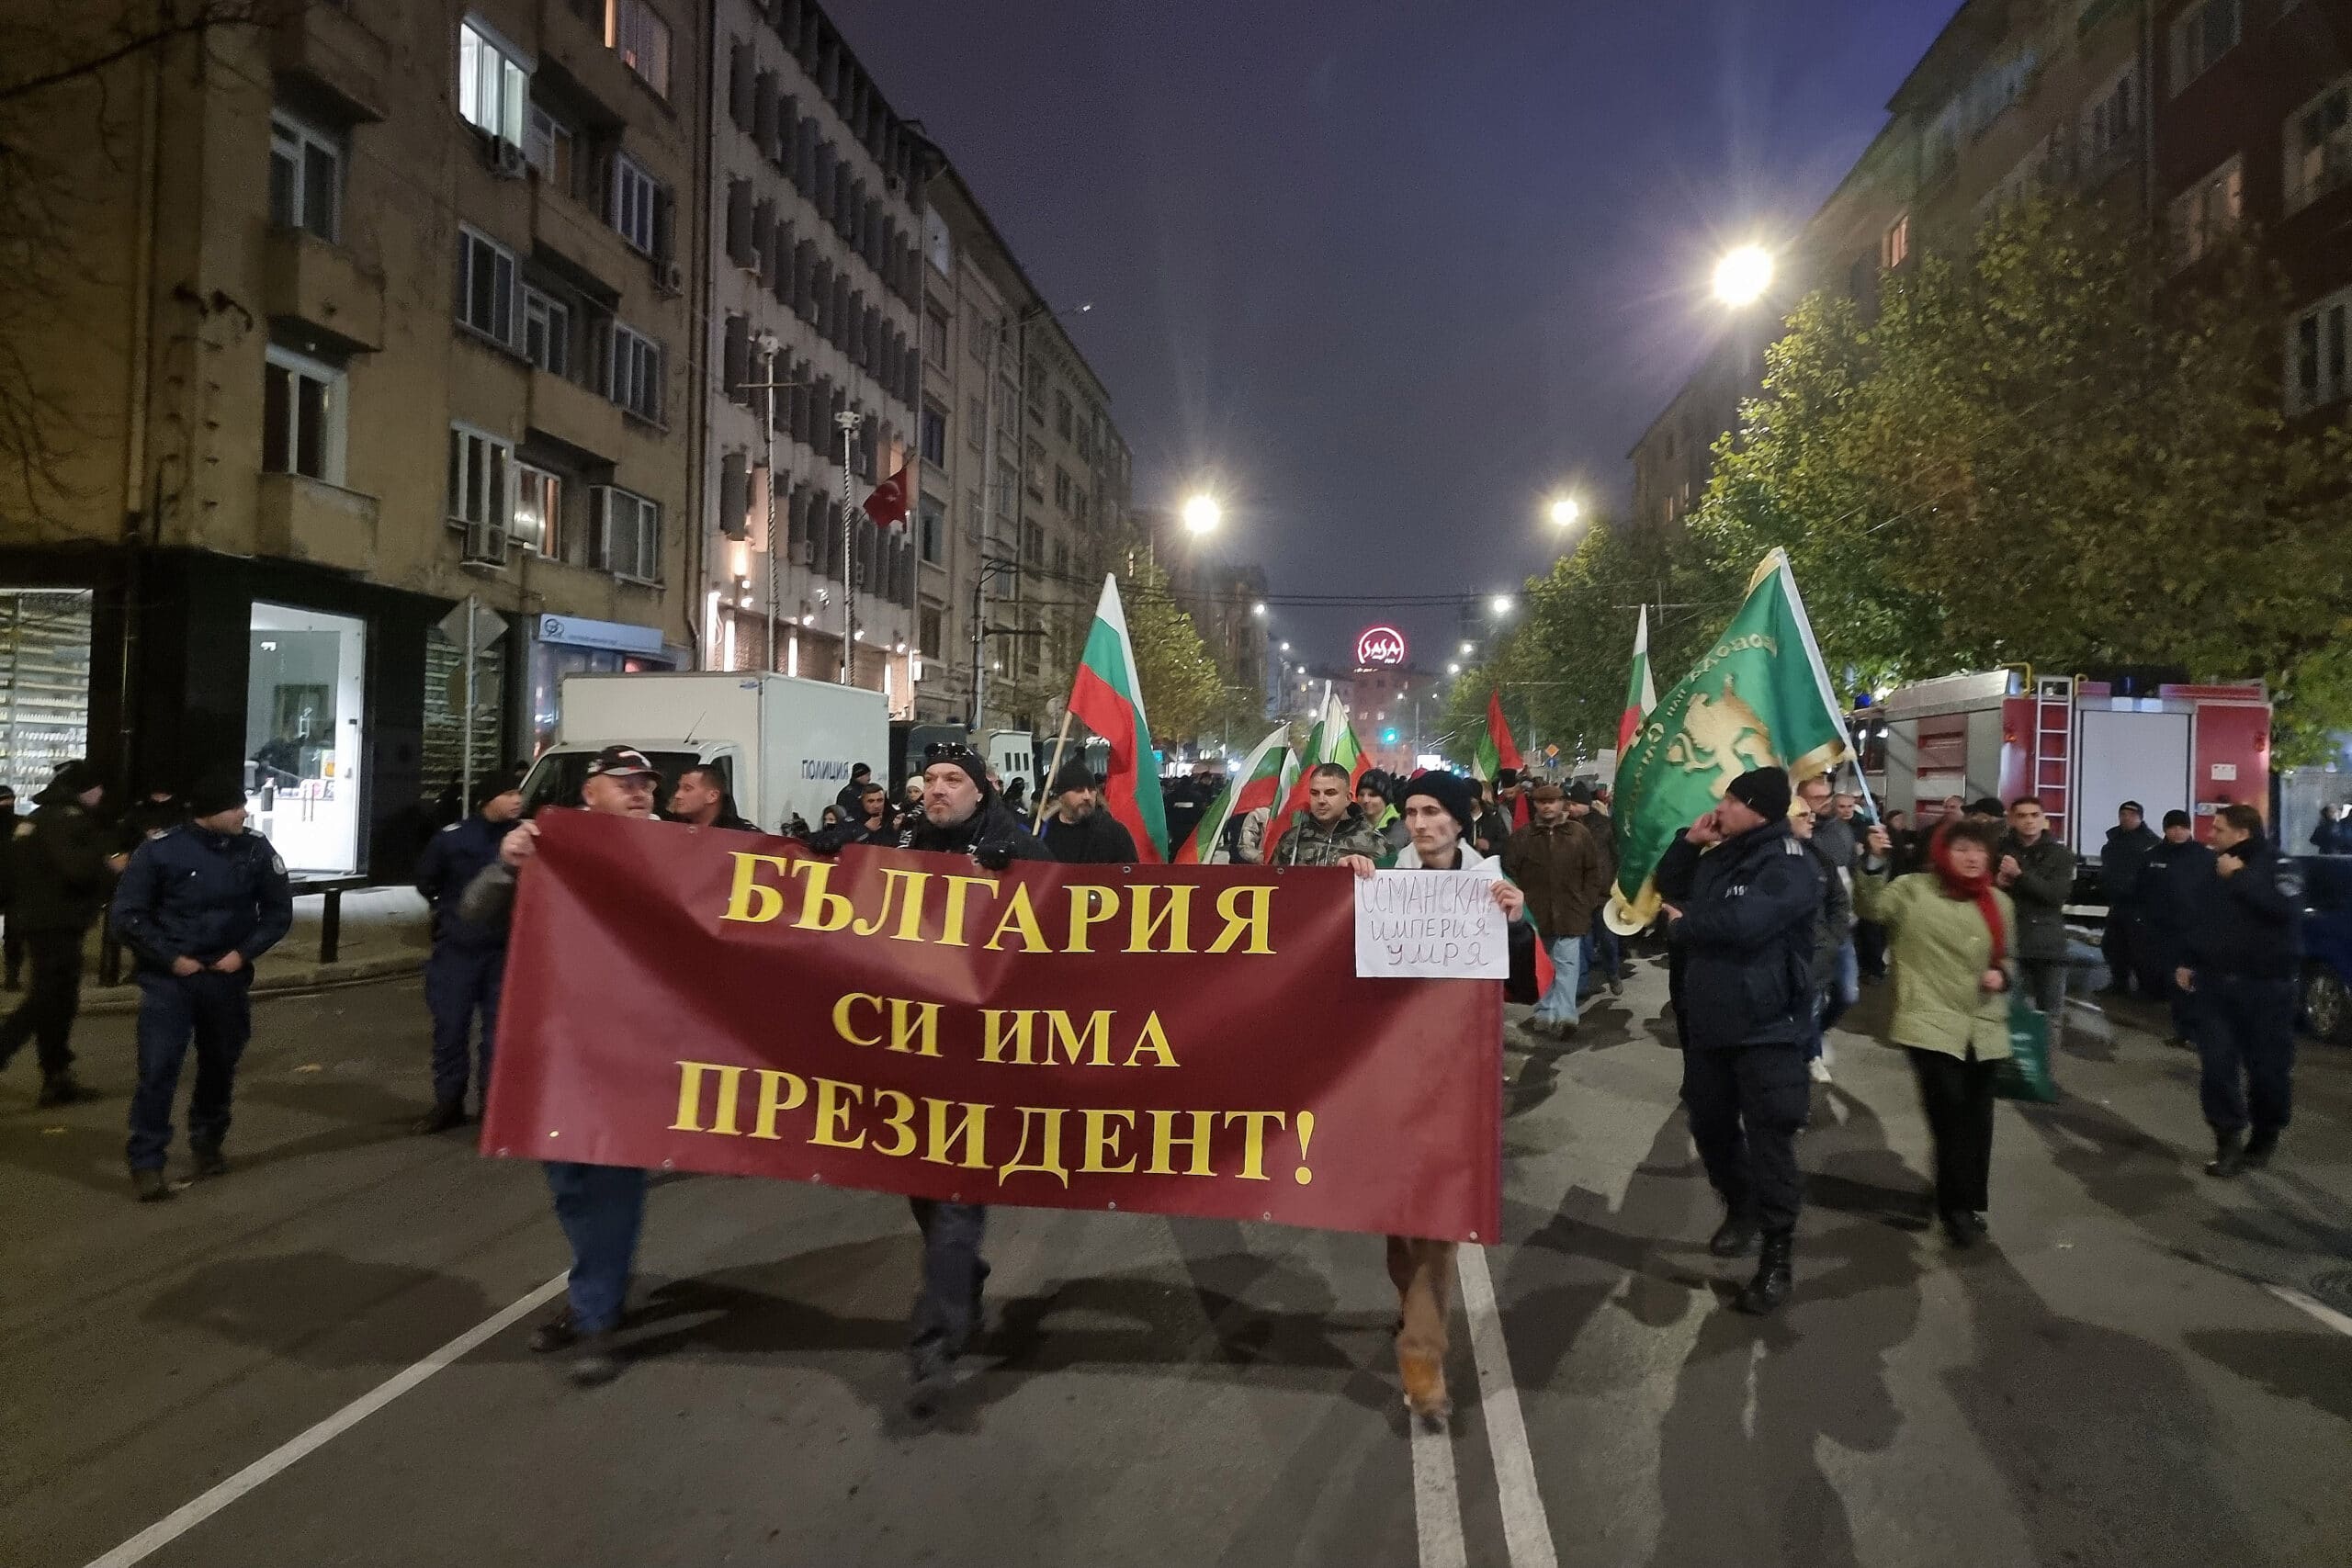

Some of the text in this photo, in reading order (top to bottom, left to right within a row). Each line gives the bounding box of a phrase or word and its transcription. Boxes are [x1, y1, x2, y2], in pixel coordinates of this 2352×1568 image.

[1363, 638, 1400, 660] SASA
[801, 760, 850, 783] ПОЛИЦИЯ
[719, 852, 1279, 955] БЪЛГАРИЯ
[1371, 918, 1489, 942] ИМПЕРИЯ
[1387, 942, 1488, 966] УМРЯ
[832, 992, 1180, 1067] СИ ИМА
[667, 1060, 1315, 1190] ПРЕЗИДЕНТ!
